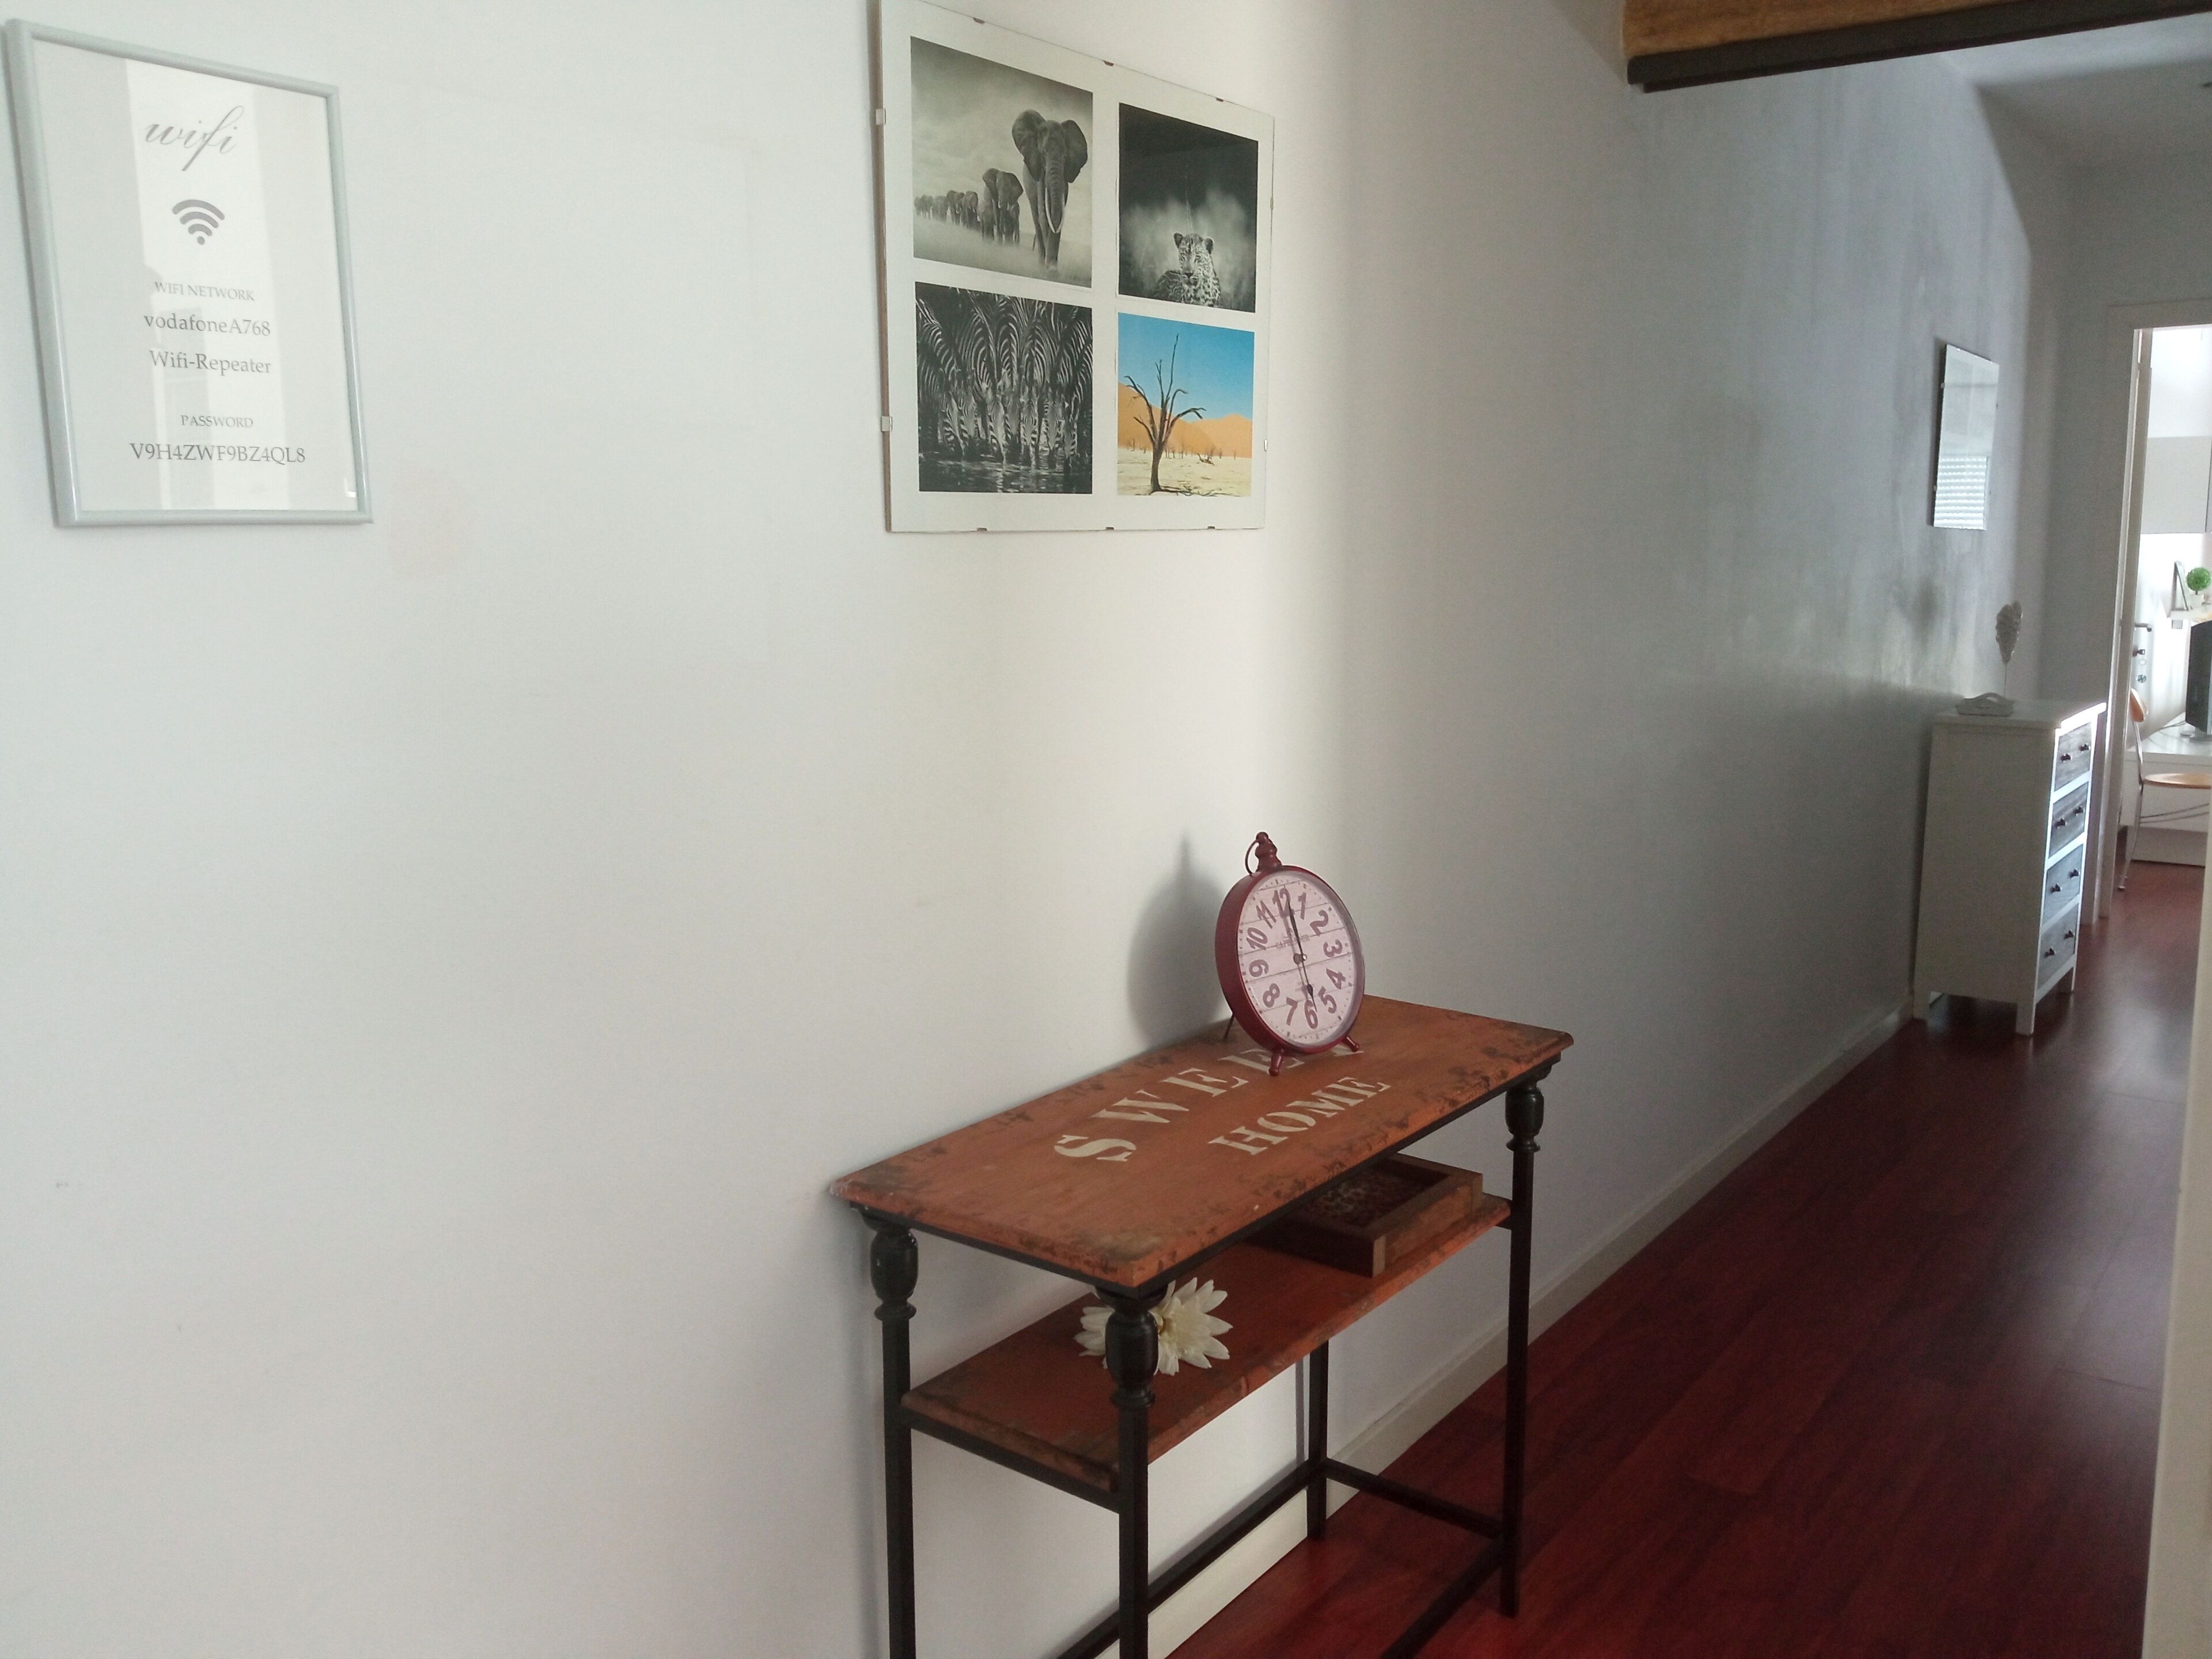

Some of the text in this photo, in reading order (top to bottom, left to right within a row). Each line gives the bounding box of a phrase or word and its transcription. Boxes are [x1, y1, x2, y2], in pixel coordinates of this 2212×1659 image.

[145, 105, 244, 172] wifi
[154, 281, 255, 301] WIFI NETWORK
[150, 350, 271, 376] Wifi-Repeater
[180, 415, 253, 428] PASSWORD
[130, 443, 305, 465] V9H4ZWF9BZ4QL8
[1256, 900, 1277, 929] 11
[1272, 888, 1295, 918] 12
[1298, 892, 1306, 920] 1
[1309, 910, 1329, 937] 2
[1246, 927, 1268, 950] 10
[1323, 940, 1343, 957] 3
[1249, 959, 1269, 978] 9
[1326, 968, 1346, 990] 4
[1263, 983, 1280, 1008] 8
[1318, 986, 1337, 1013] 5
[1286, 997, 1298, 1026] 7
[1304, 999, 1318, 1029] 6
[1054, 1040, 1364, 1162] SWEE
[1208, 1076, 1391, 1155] HOME
